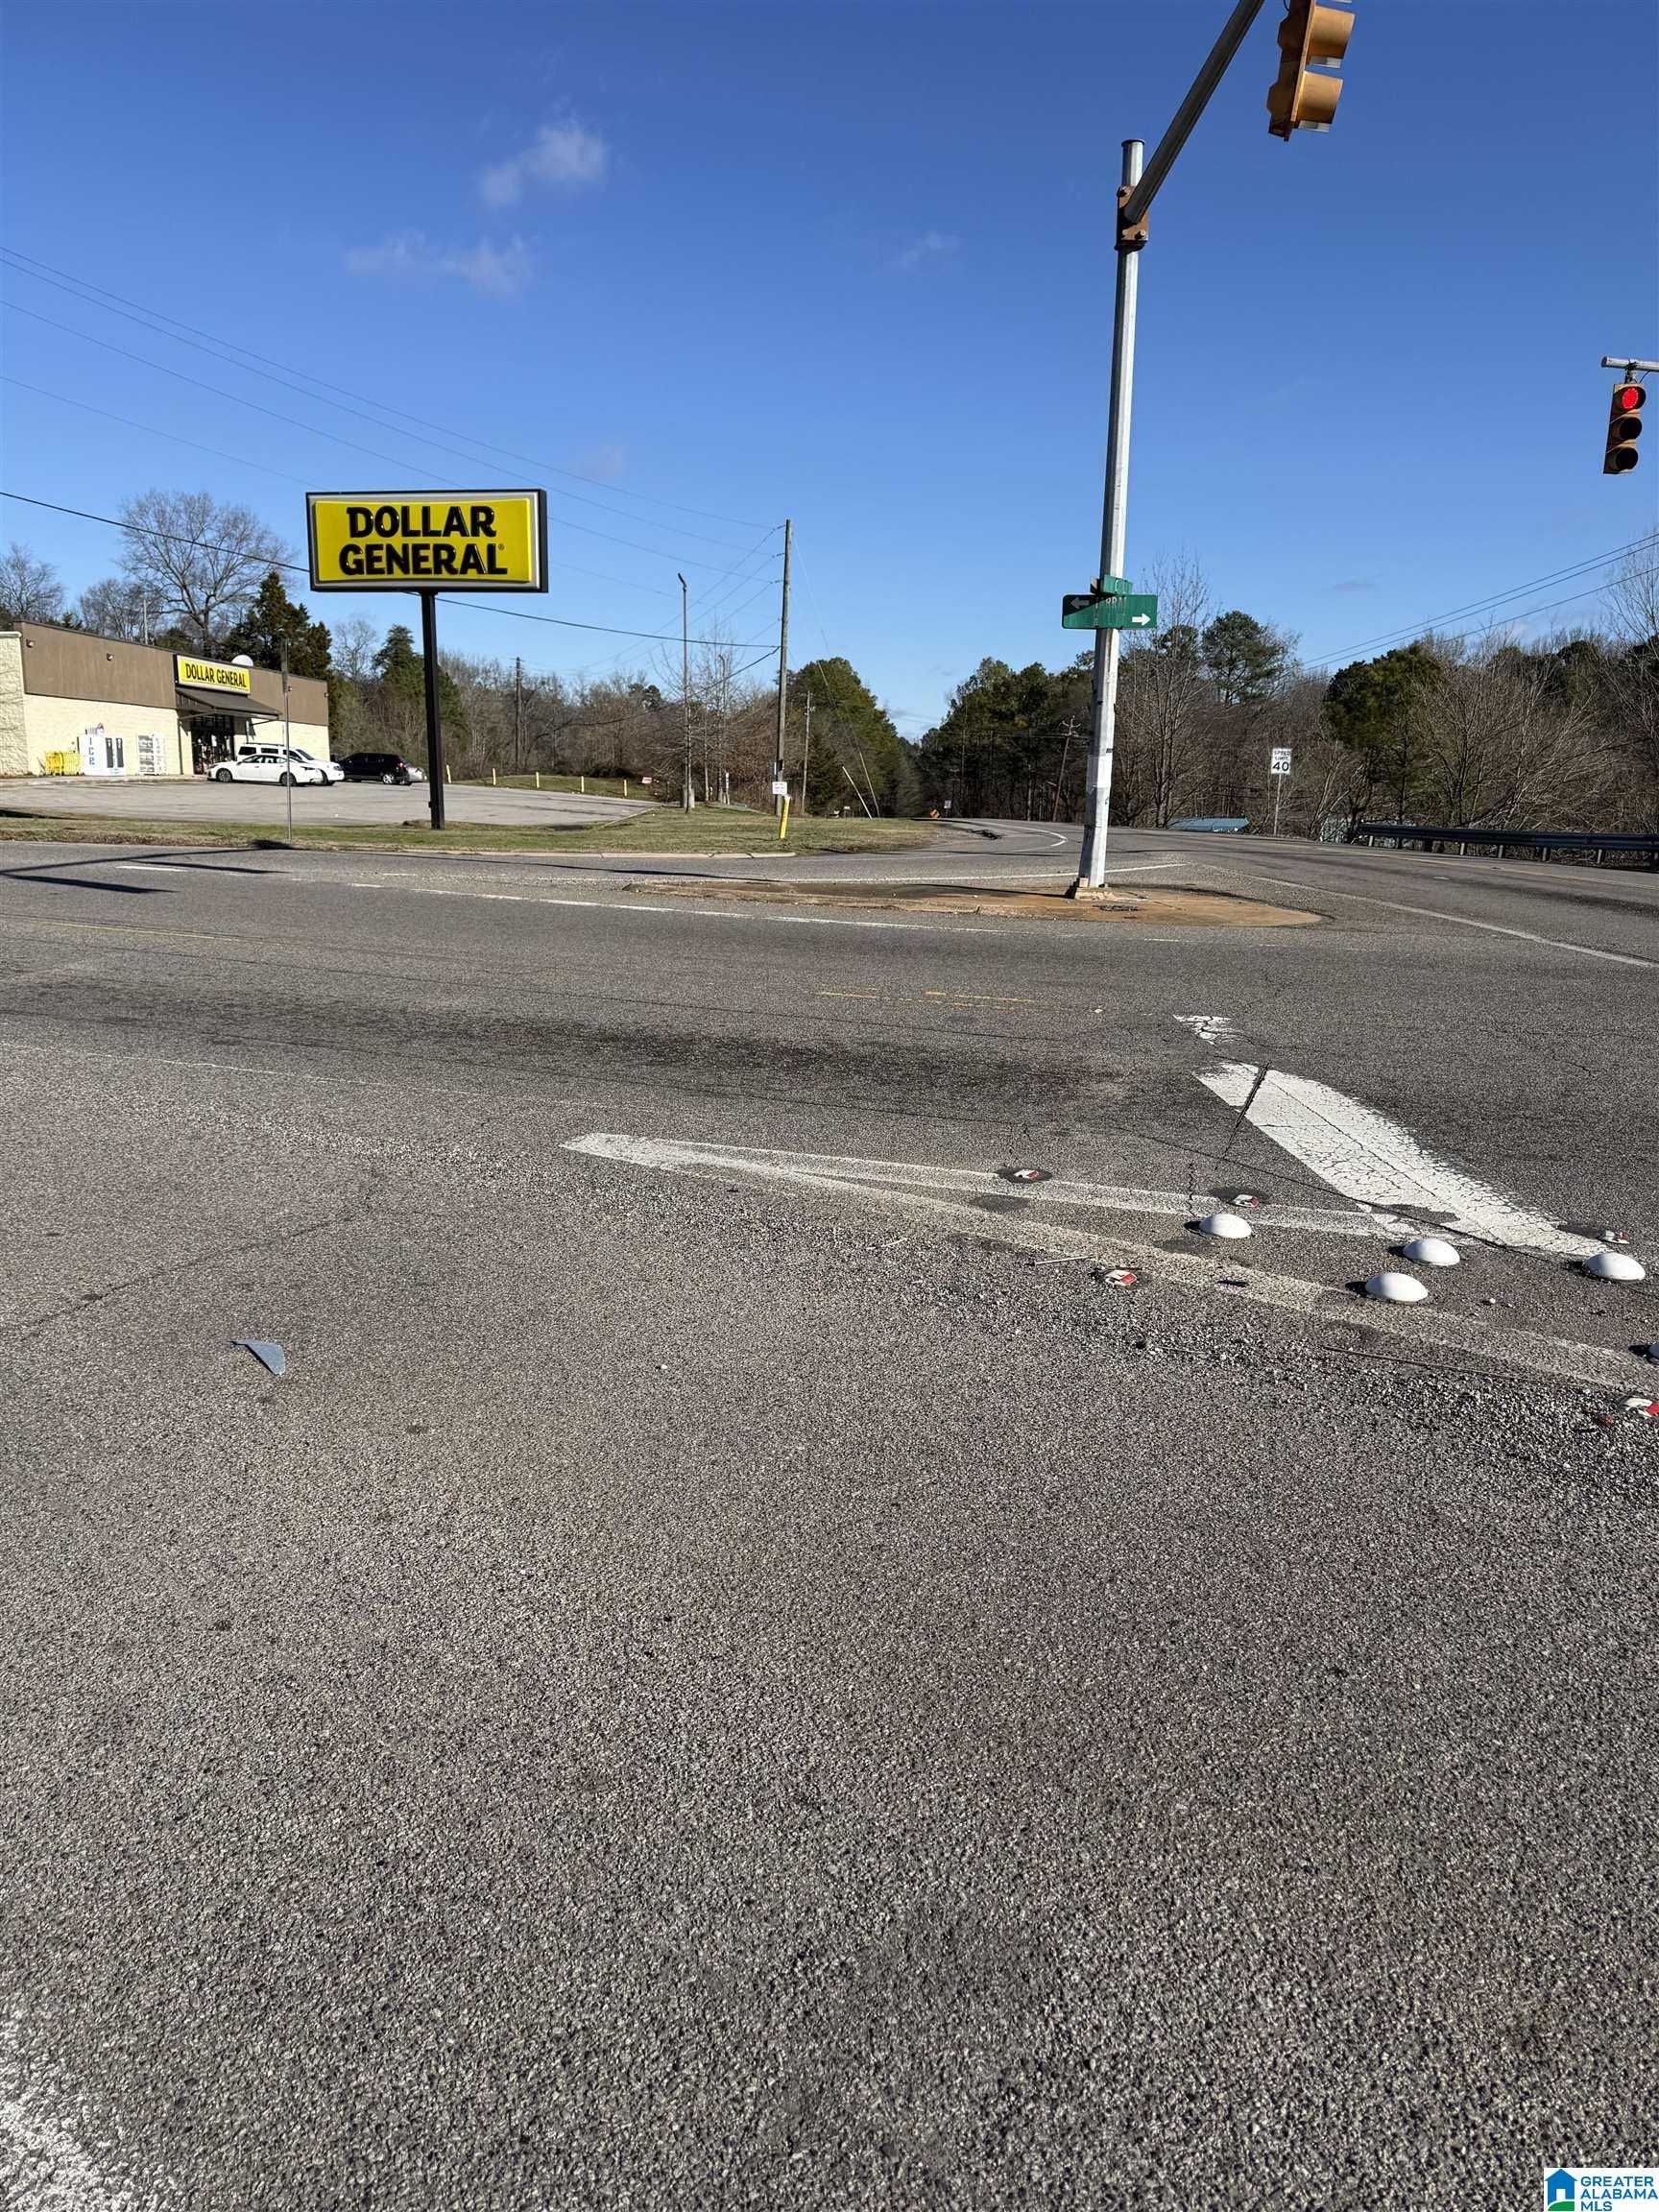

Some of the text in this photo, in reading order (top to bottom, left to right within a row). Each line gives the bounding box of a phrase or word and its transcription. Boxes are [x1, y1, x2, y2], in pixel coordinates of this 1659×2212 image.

[346, 505, 496, 539] DOLLAR
[338, 542, 508, 576] GENERAL
[184, 662, 247, 688] DOLLAR GENERAL
[1272, 761, 1289, 772] 40
